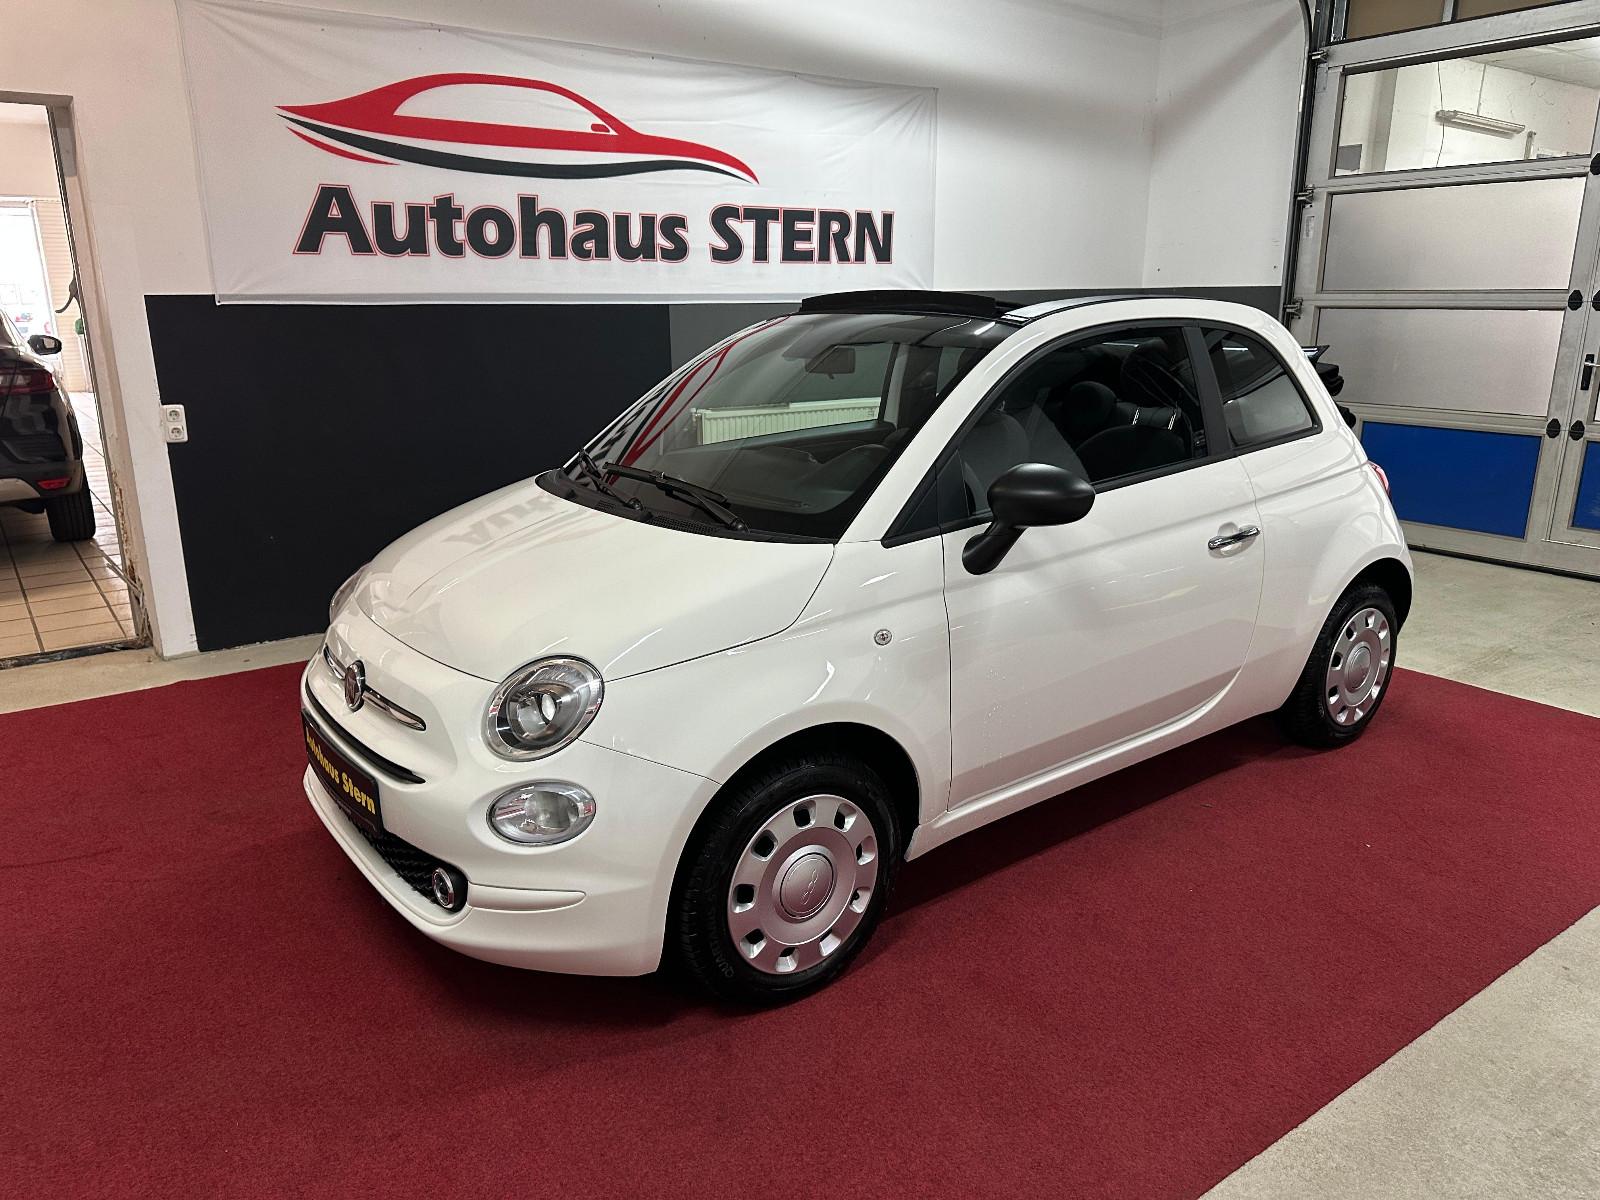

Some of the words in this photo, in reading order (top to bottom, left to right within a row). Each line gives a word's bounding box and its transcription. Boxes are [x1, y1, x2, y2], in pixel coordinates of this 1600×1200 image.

[293, 183, 689, 263] Autohaus
[709, 204, 894, 265] STERN
[341, 771, 376, 815] Stern
